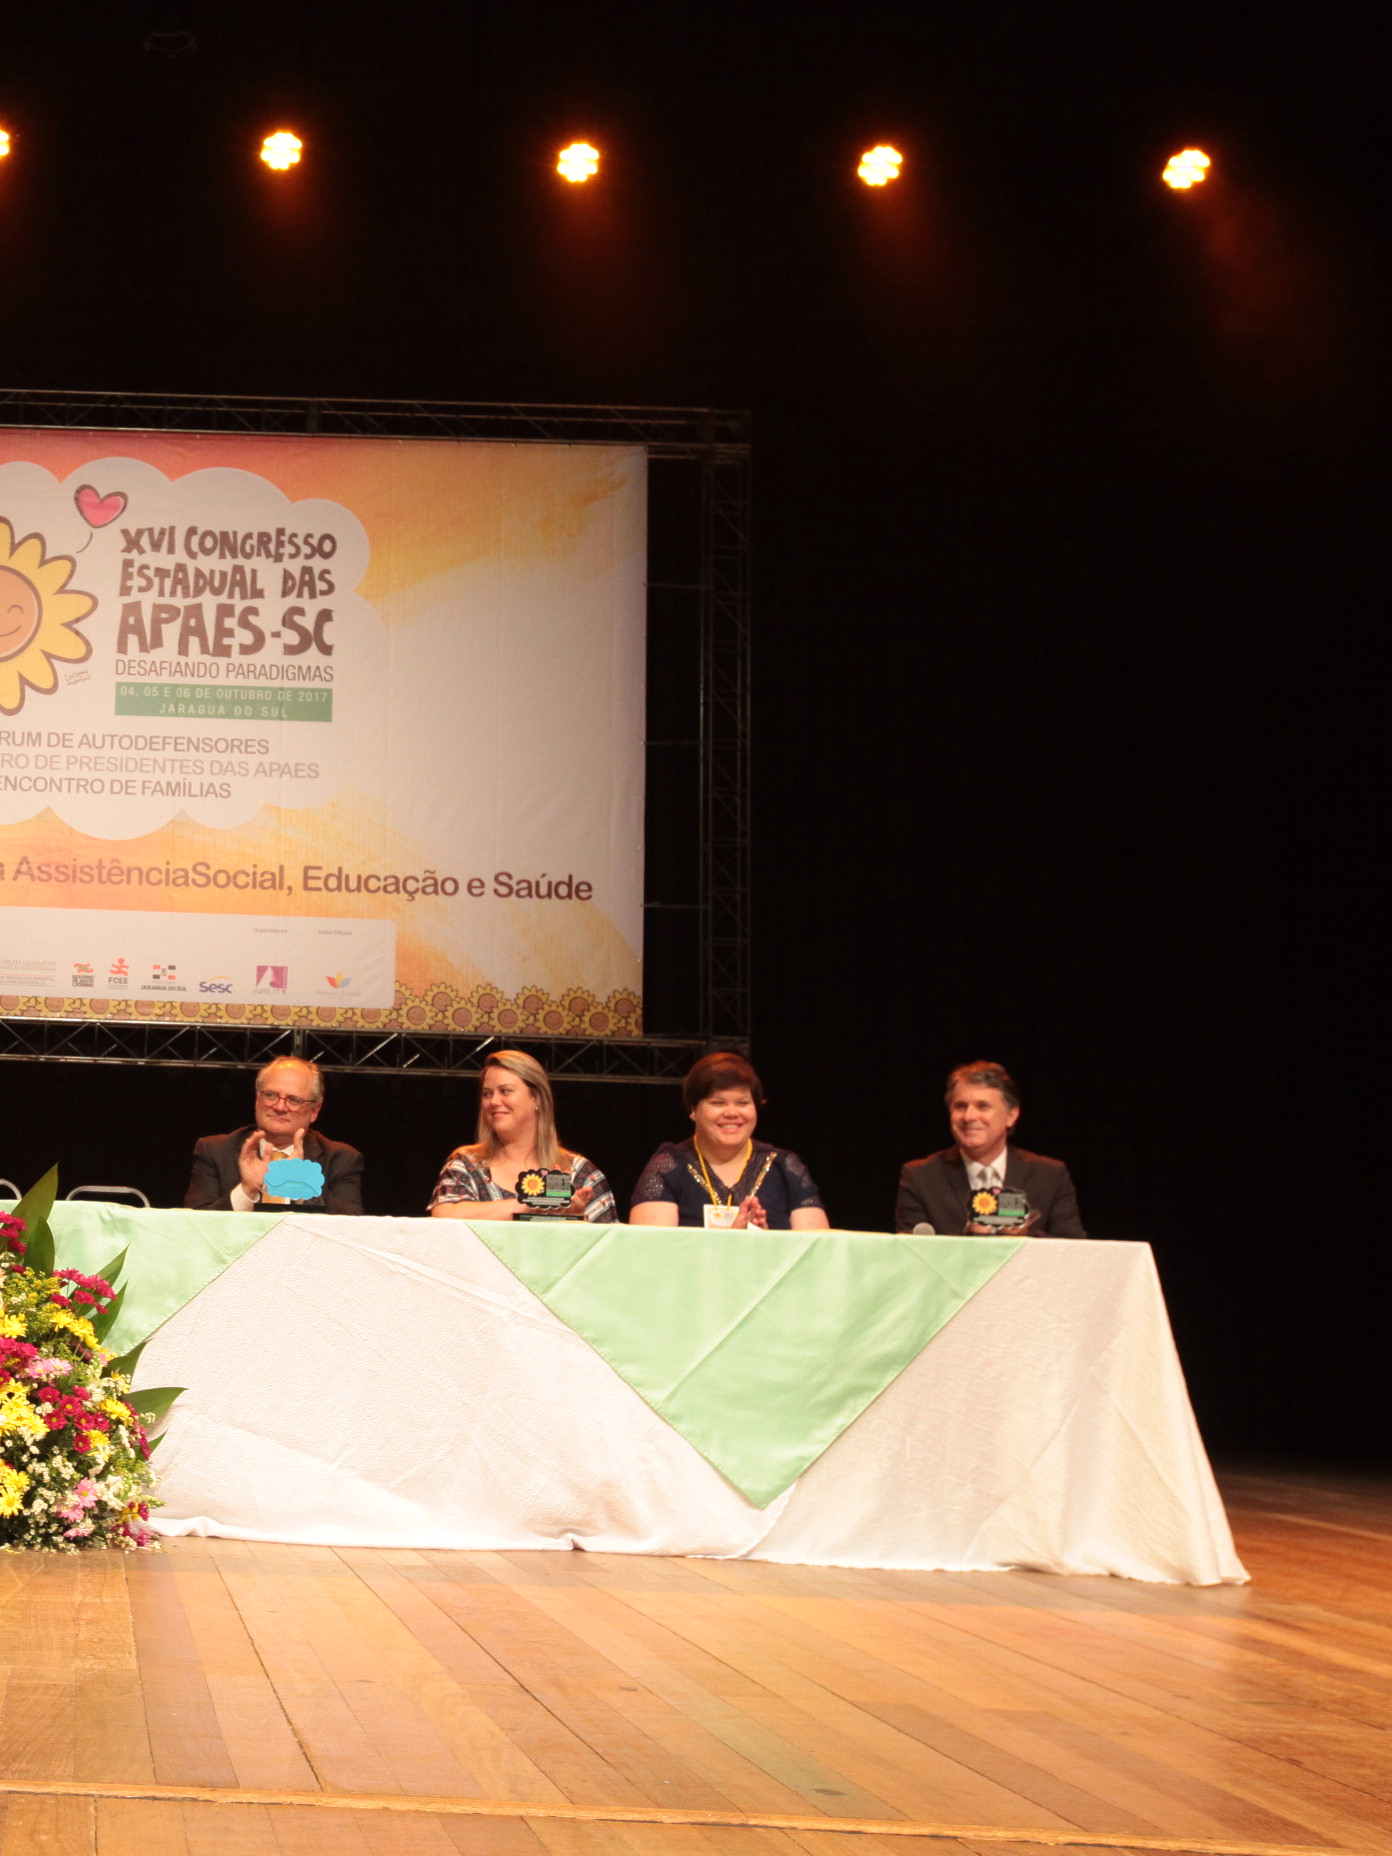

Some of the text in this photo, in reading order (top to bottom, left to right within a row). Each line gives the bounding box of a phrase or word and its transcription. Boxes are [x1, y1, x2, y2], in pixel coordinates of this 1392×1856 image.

[120, 525, 337, 563] XVI CONGRESSO
[119, 558, 335, 600] ESTADUAL DAS
[116, 600, 334, 658] APAES-SC
[115, 659, 334, 682] DESAFIANDO PARADIGMAS
[144, 686, 158, 697] 05
[164, 687, 170, 697] E
[175, 687, 191, 698] 06
[196, 688, 210, 698] DE
[216, 688, 272, 701] OUTUBRO
[278, 690, 293, 701] DE
[298, 691, 328, 702] 2017
[234, 705, 253, 717] DO
[261, 706, 288, 718] SUL
[47, 732, 74, 748] DE
[77, 733, 270, 755] AUTODEFENSORES
[35, 754, 61, 770] DE
[66, 754, 205, 776] PRESIDENTES
[210, 760, 250, 777] DAS
[254, 761, 320, 779] APAES
[110, 779, 137, 795] DE
[141, 778, 232, 798] FAMÍLIAS
[302, 865, 459, 901] Educação
[466, 876, 486, 897] e
[493, 871, 593, 901] Saúde
[199, 981, 233, 993] Sesc
